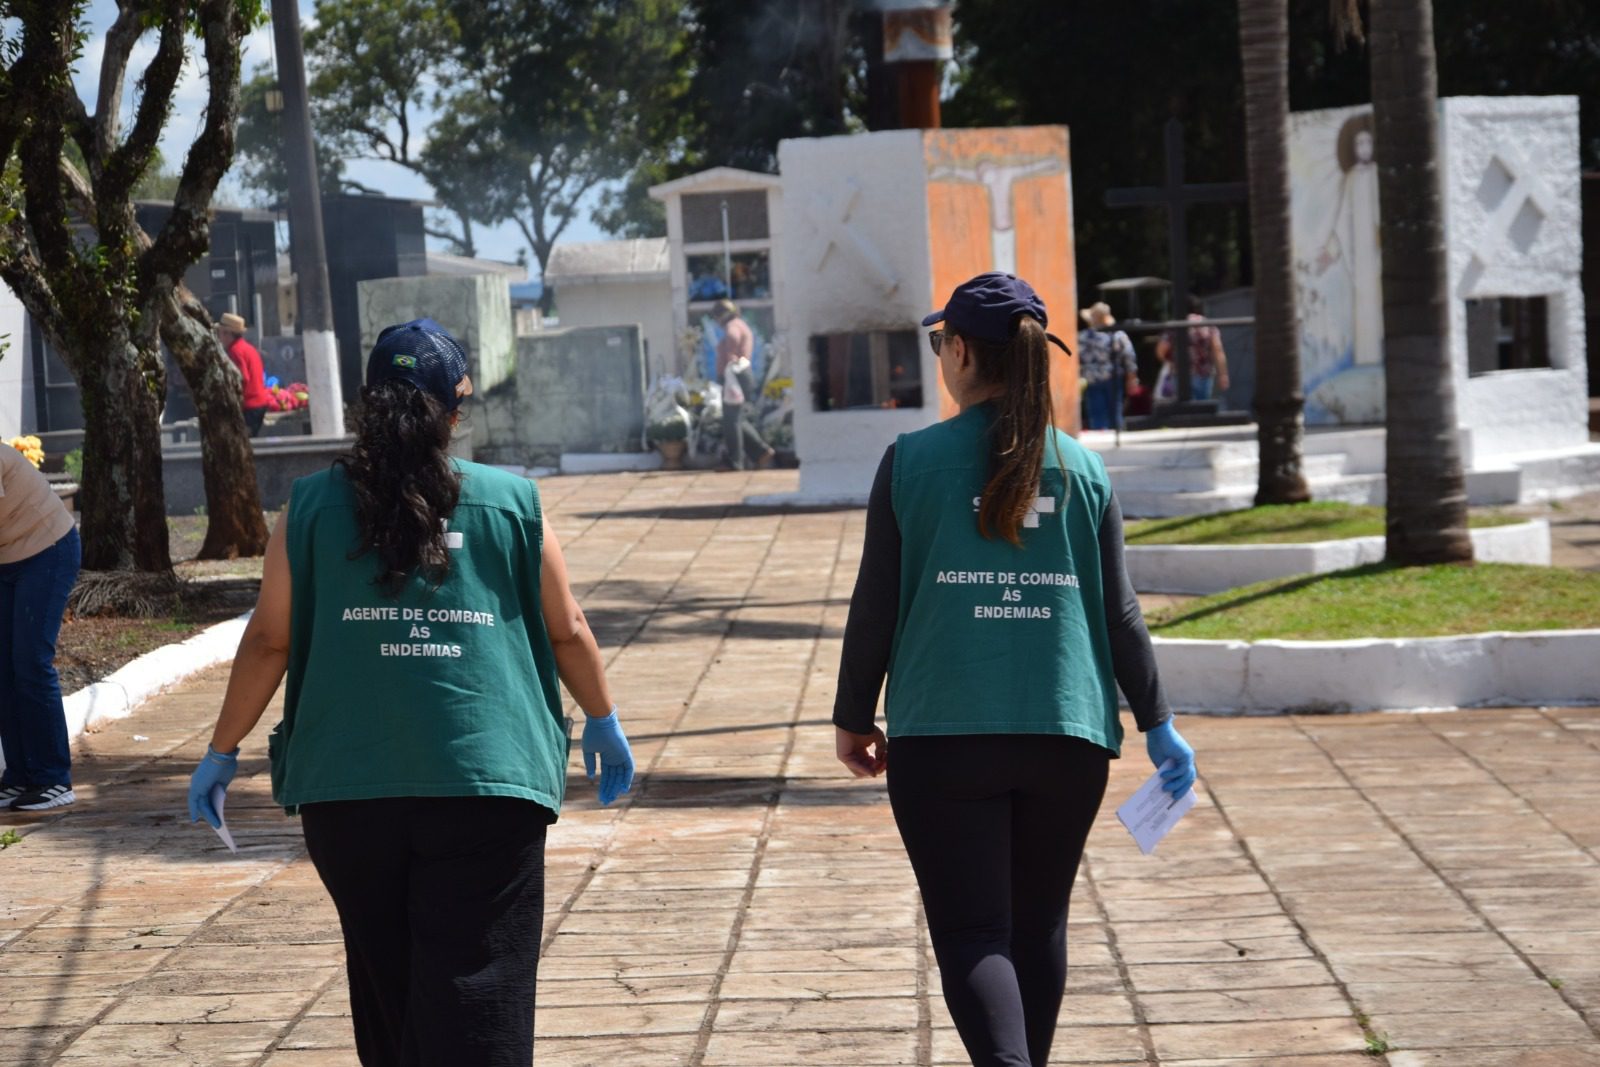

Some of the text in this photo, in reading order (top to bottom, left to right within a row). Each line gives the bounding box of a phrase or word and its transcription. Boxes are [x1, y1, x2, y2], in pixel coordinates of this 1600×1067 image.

[937, 571, 994, 583] AGENTE
[998, 572, 1016, 584] DE
[342, 607, 494, 625] AGENTE DE COMBATE
[974, 606, 1051, 619] ENDEMIAS
[380, 644, 461, 657] ENDEMIAS
